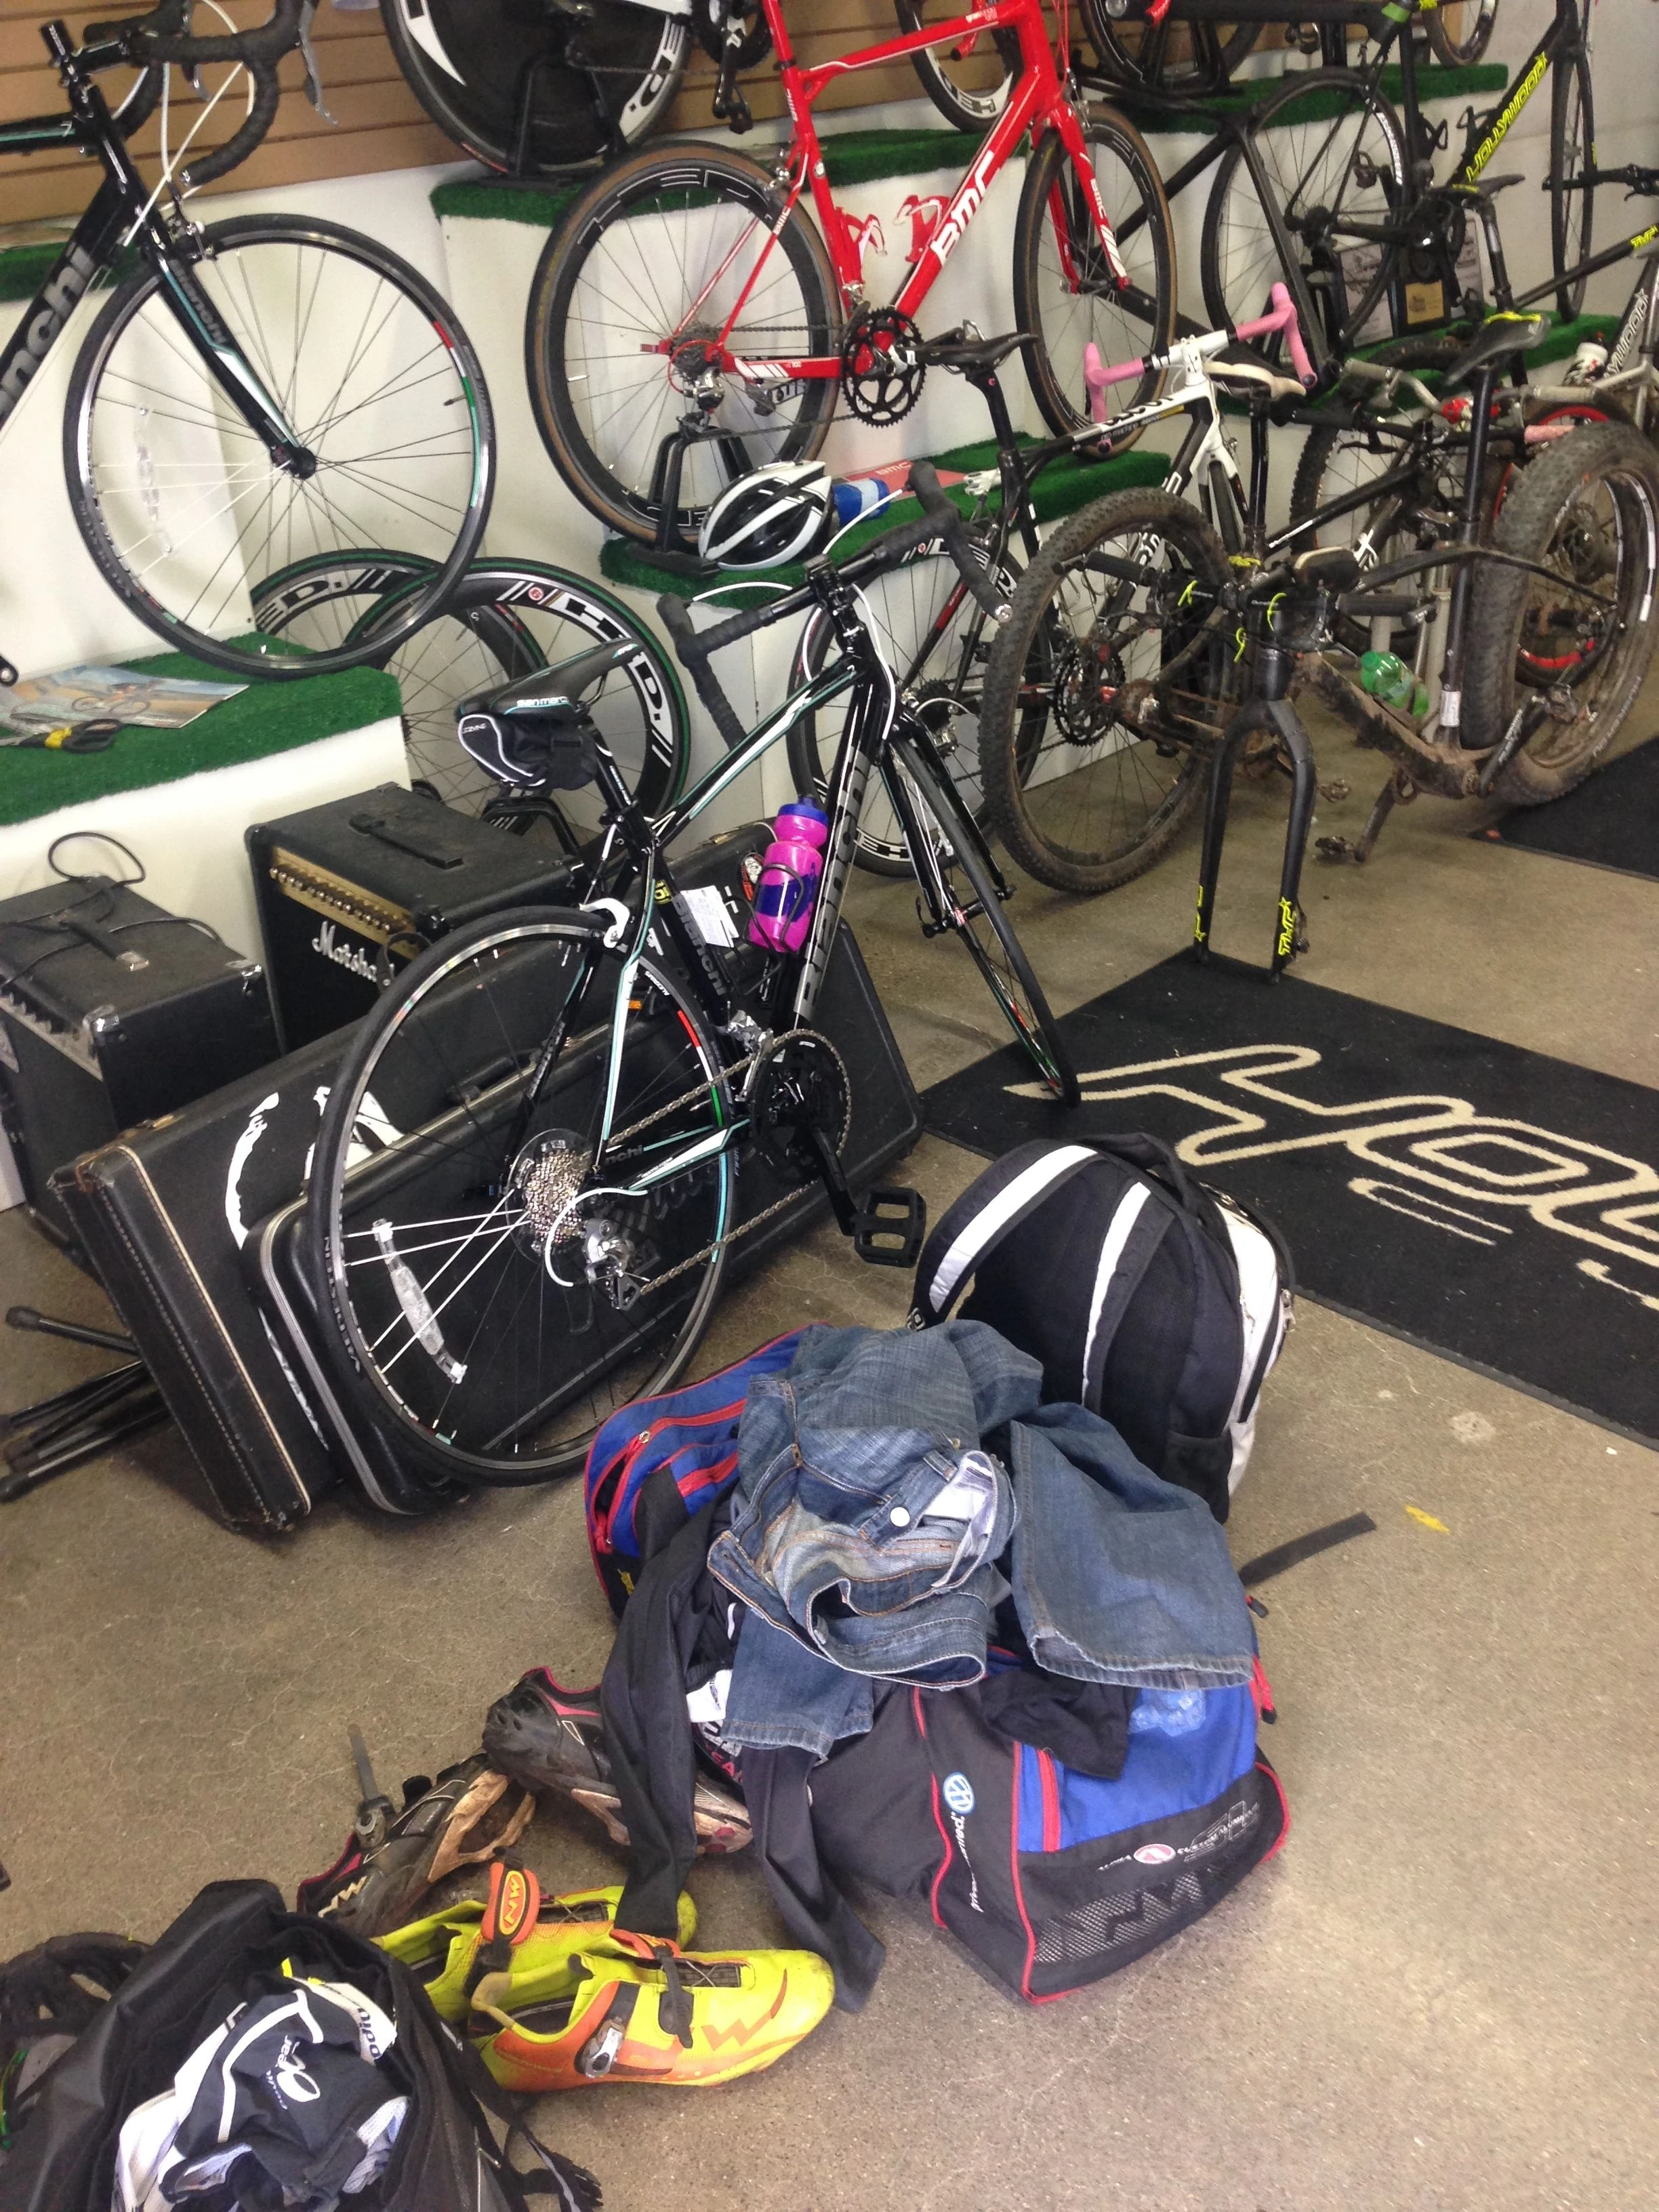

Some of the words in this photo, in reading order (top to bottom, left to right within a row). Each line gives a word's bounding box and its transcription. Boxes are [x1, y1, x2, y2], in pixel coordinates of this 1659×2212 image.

[930, 150, 995, 266] BMC
[1090, 178, 1107, 220] BMC
[0, 241, 96, 416] nchi
[876, 460, 912, 475] BMC
[259, 577, 342, 628] ED.
[564, 598, 663, 721] HD.
[793, 744, 871, 1022] Bianchi
[311, 920, 395, 983] Marshal
[672, 893, 727, 996] Bianchi
